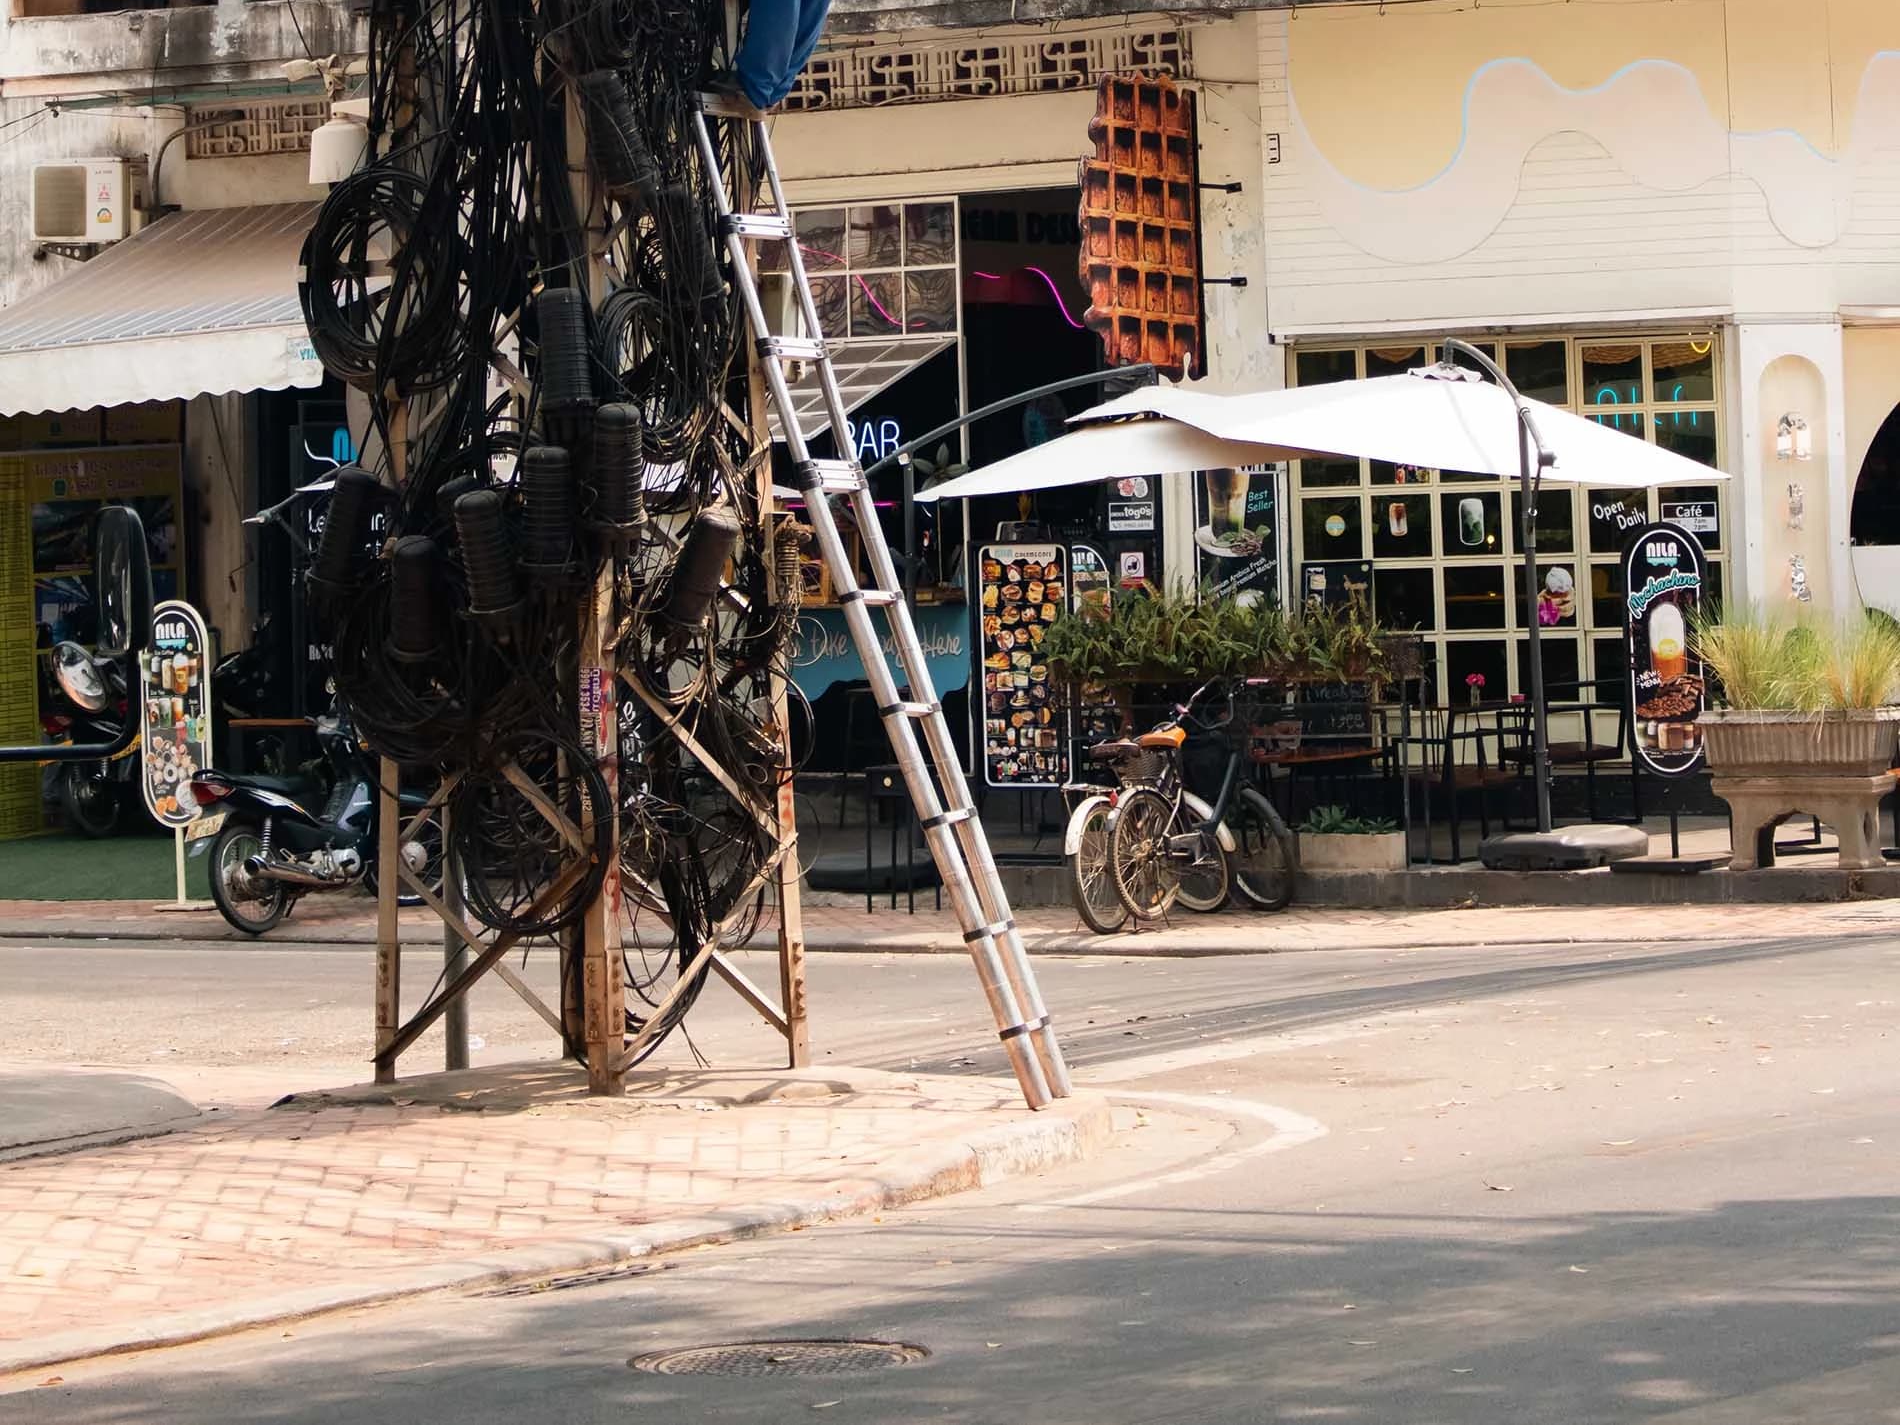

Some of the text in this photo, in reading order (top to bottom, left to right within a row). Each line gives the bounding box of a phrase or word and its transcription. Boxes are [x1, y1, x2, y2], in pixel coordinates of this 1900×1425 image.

[1248, 489, 1268, 501] Best
[1247, 500, 1274, 513] Seller
[1593, 501, 1625, 520] Open
[1675, 504, 1703, 518] Café
[1616, 507, 1647, 530] Daily
[1646, 542, 1678, 557] NILA
[155, 622, 186, 639] NILA
